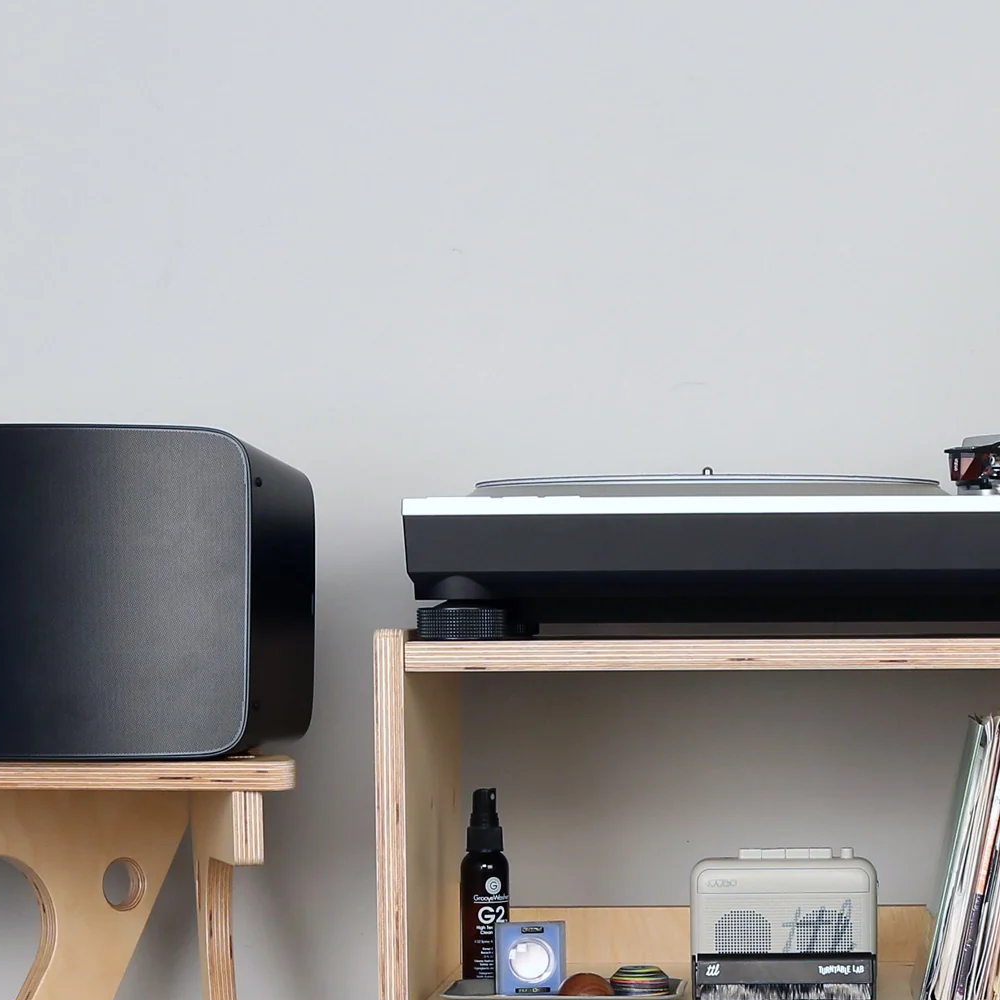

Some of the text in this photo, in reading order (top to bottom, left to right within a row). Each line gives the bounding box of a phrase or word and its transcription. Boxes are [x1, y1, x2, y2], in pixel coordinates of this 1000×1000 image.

[478, 906, 505, 924] G2
[706, 964, 720, 976] ttl
[818, 965, 865, 975] TURNTABLE LAB
